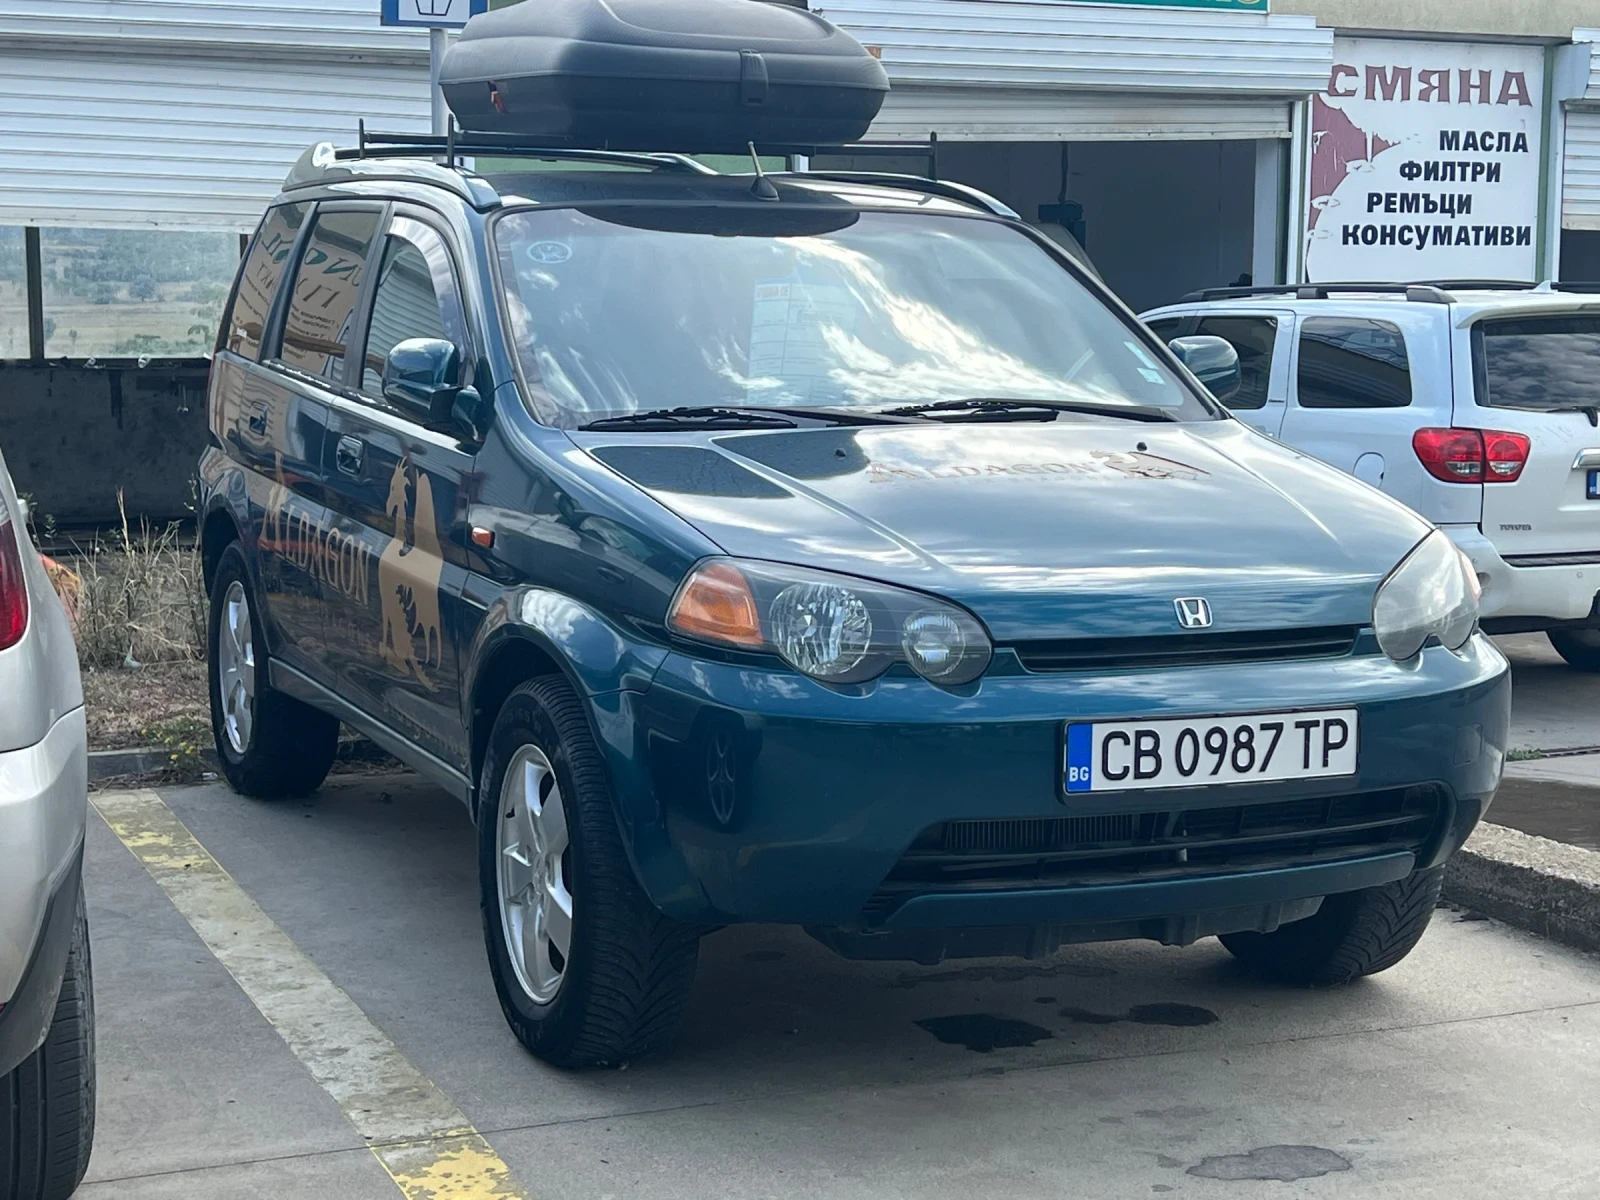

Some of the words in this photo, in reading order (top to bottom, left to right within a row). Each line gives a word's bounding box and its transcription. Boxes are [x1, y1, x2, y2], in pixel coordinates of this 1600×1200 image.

[1327, 64, 1533, 107] СМЯНА
[1439, 130, 1529, 153] МАСЛА
[1399, 160, 1502, 183] ФИЛТРИ
[1366, 192, 1473, 219] РЕМЪЦИ
[1341, 224, 1532, 251] КОНСУМАТИВИ
[1101, 730, 1163, 781] CB
[1175, 722, 1284, 777] 0987
[1295, 717, 1349, 769] TP
[1068, 766, 1090, 782] BG
